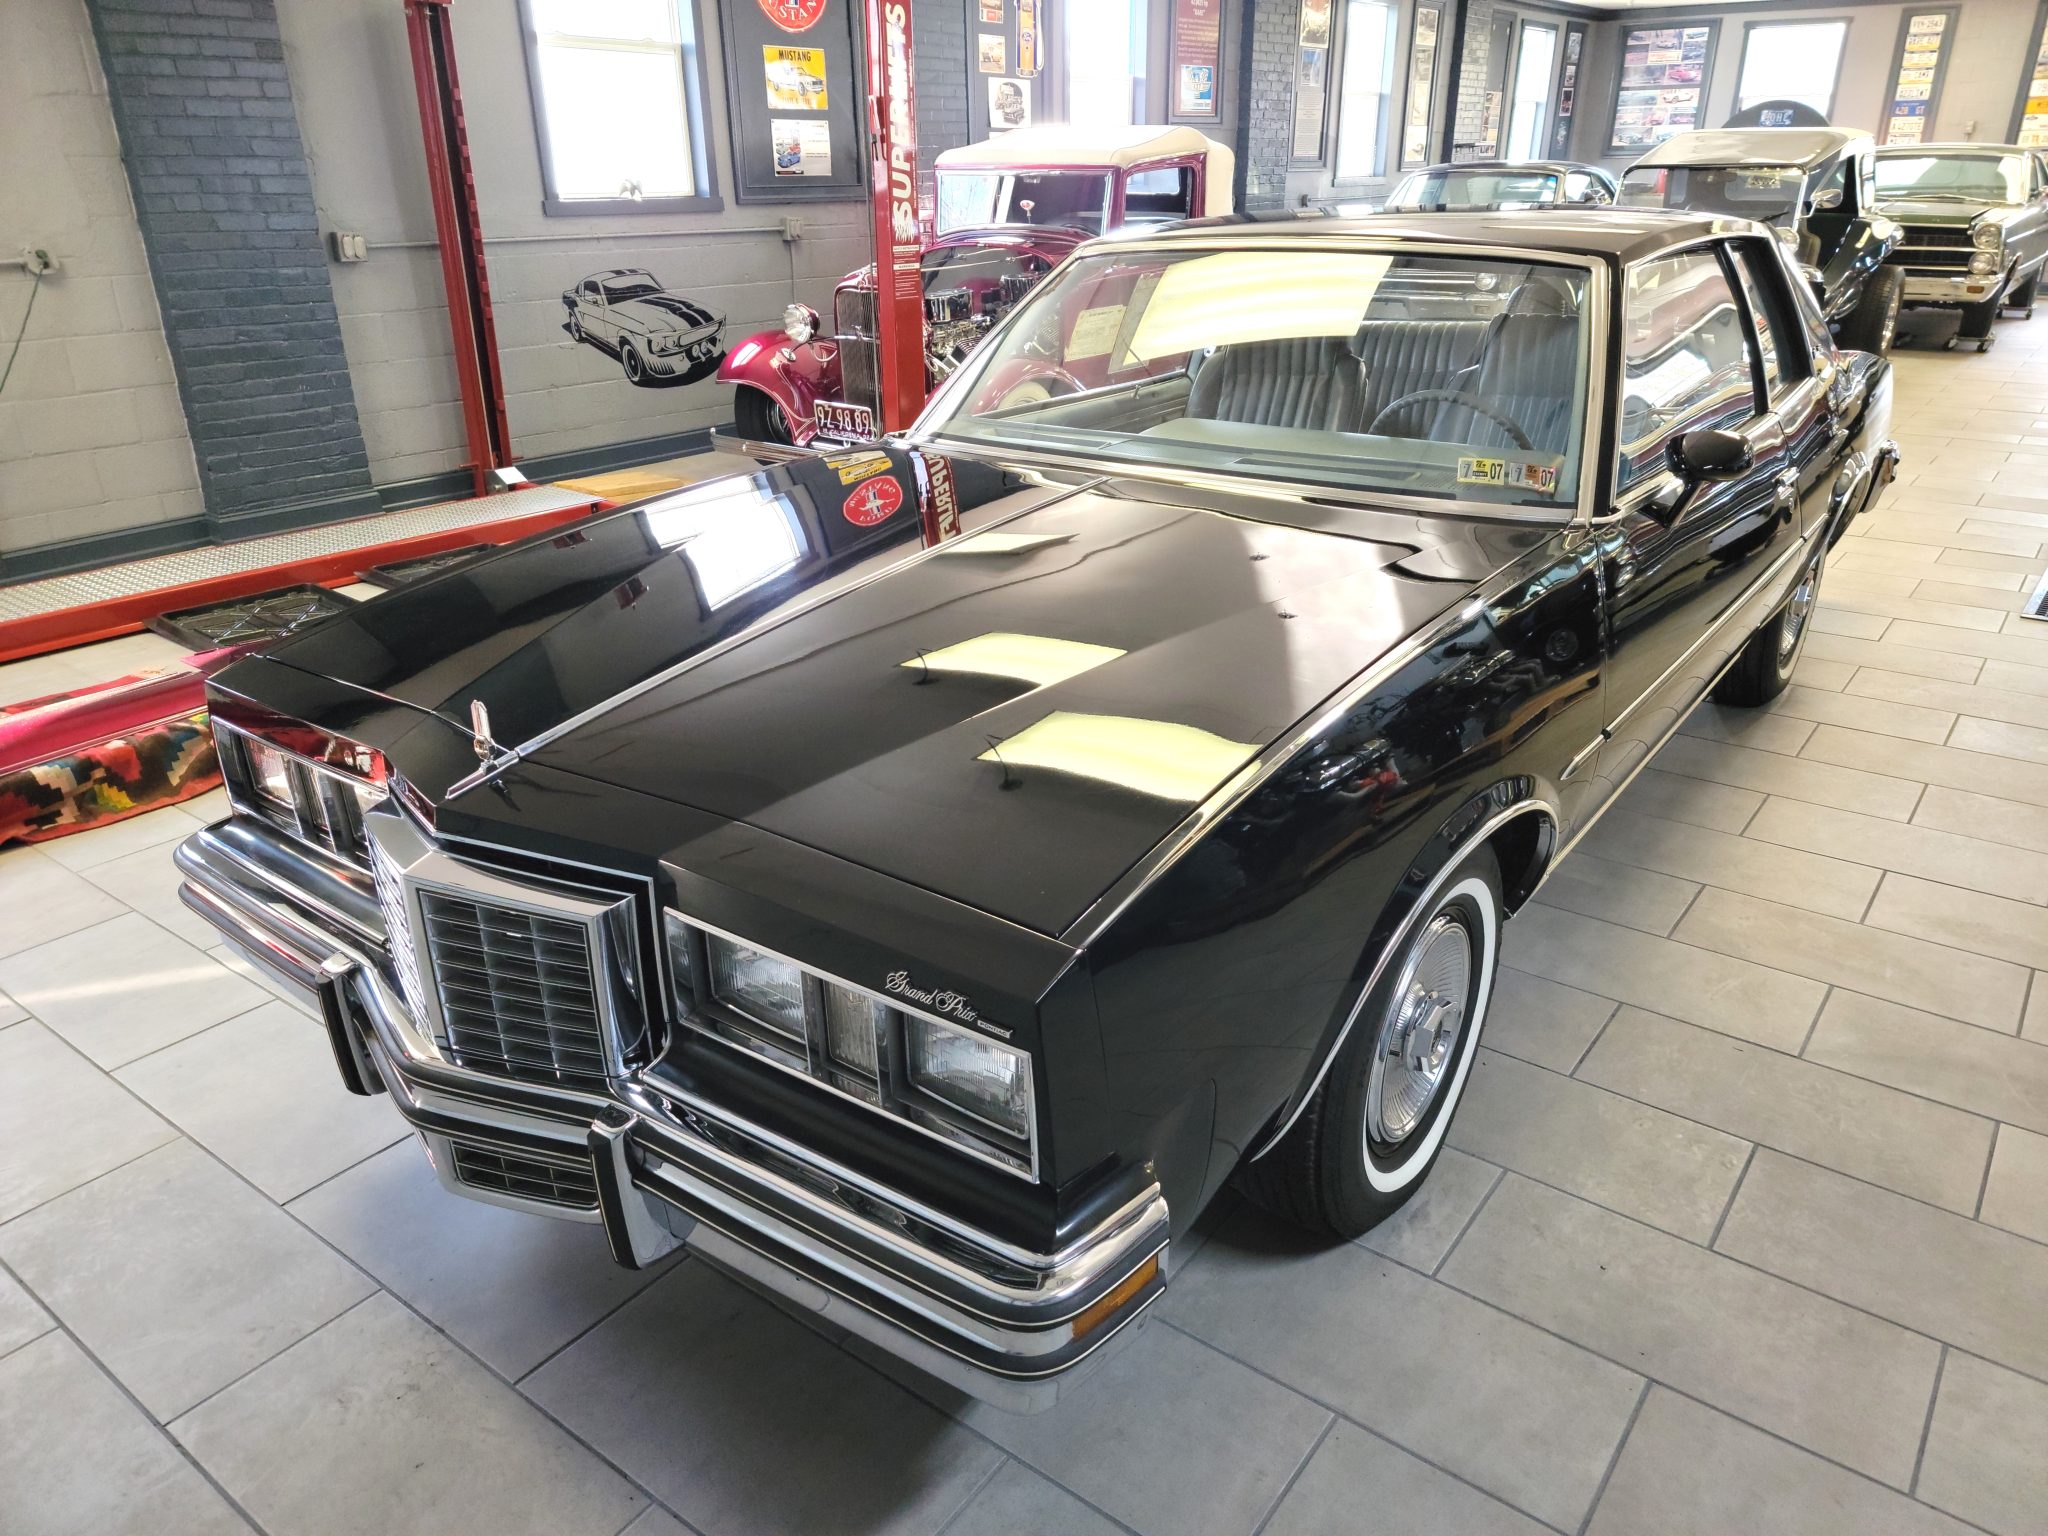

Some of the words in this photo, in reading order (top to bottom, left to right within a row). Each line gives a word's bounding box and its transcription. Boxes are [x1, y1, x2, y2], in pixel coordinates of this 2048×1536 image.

[778, 49, 812, 62] MUSTANG
[817, 404, 834, 428] 9Z
[836, 408, 852, 431] 98
[854, 410, 870, 434] 89
[1463, 463, 1472, 478] 7
[1489, 462, 1504, 480] 07
[1514, 467, 1523, 482] 7
[1540, 469, 1556, 488] 07
[885, 970, 938, 1006] Grand
[935, 990, 979, 1022] Prix
